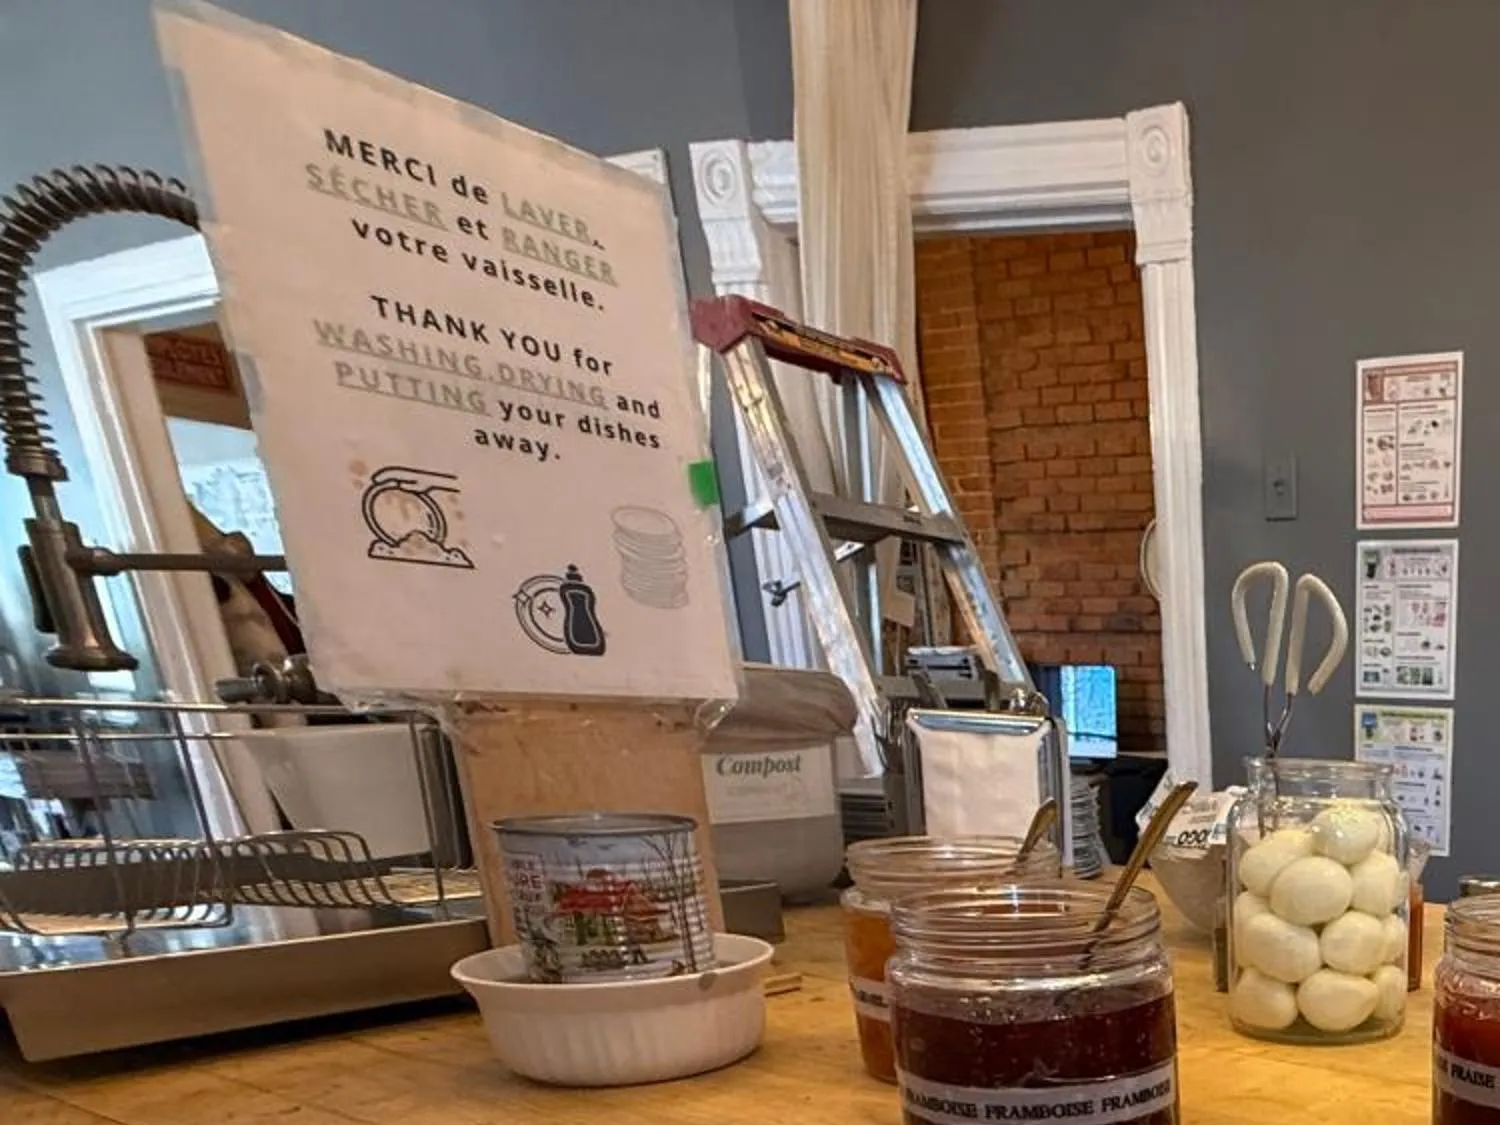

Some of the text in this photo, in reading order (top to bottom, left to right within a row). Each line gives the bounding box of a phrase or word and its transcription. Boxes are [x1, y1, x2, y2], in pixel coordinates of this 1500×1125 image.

[323, 129, 437, 186] MERCI
[451, 175, 488, 204] de
[306, 162, 618, 288] SÉCHER et RANGER
[352, 219, 604, 311] votre vaisselle.
[371, 295, 613, 377] THANK YOU for
[335, 361, 660, 449] PUTTING your dishes
[617, 395, 660, 420] and
[474, 428, 561, 462] away.
[716, 754, 801, 779] Compost
[1451, 1063, 1495, 1089] FRAISE
[984, 1099, 1094, 1121] FRAMBOISE
